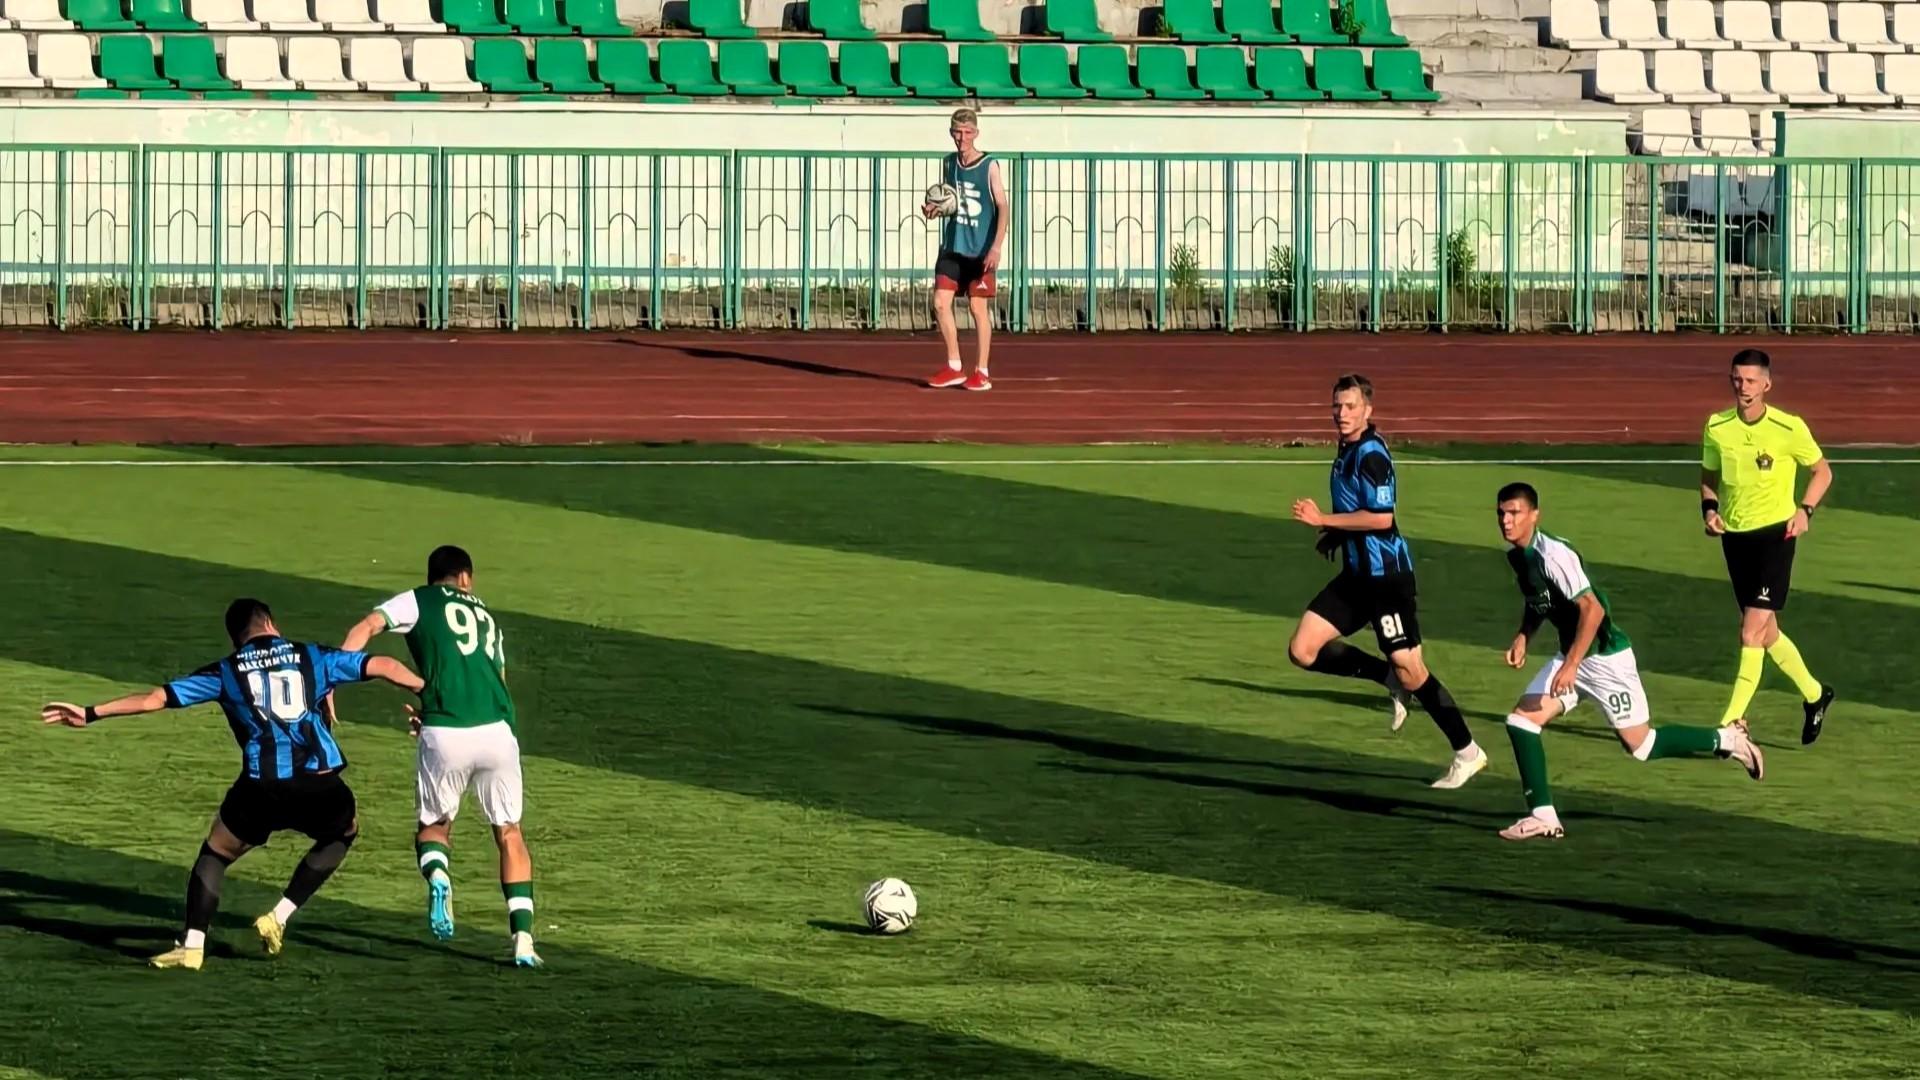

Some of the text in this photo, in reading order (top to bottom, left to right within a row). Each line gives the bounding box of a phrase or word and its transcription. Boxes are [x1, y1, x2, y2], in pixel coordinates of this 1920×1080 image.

[444, 601, 496, 661] 97
[1380, 612, 1405, 638] 81
[246, 669, 308, 722] 10
[1608, 691, 1632, 714] 99
